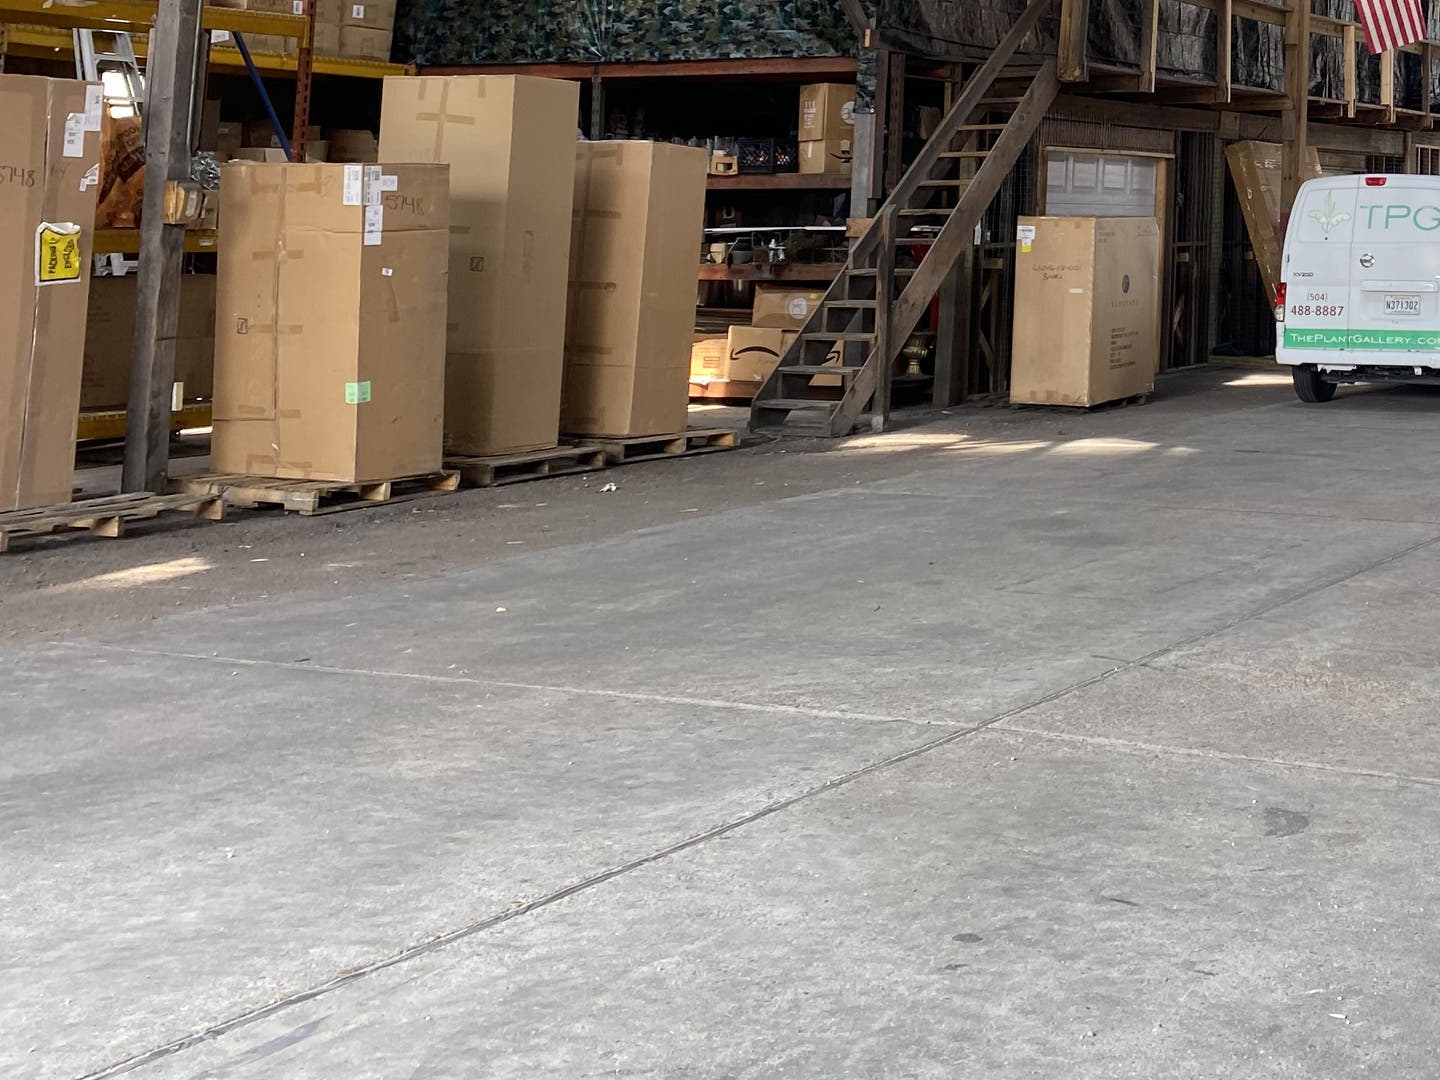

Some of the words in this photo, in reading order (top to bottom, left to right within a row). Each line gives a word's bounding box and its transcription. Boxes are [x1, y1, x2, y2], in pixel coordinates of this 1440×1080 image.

[386, 194, 424, 216] 5748
[1306, 292, 1328, 302] (504)
[1291, 304, 1344, 317] 488-8887
